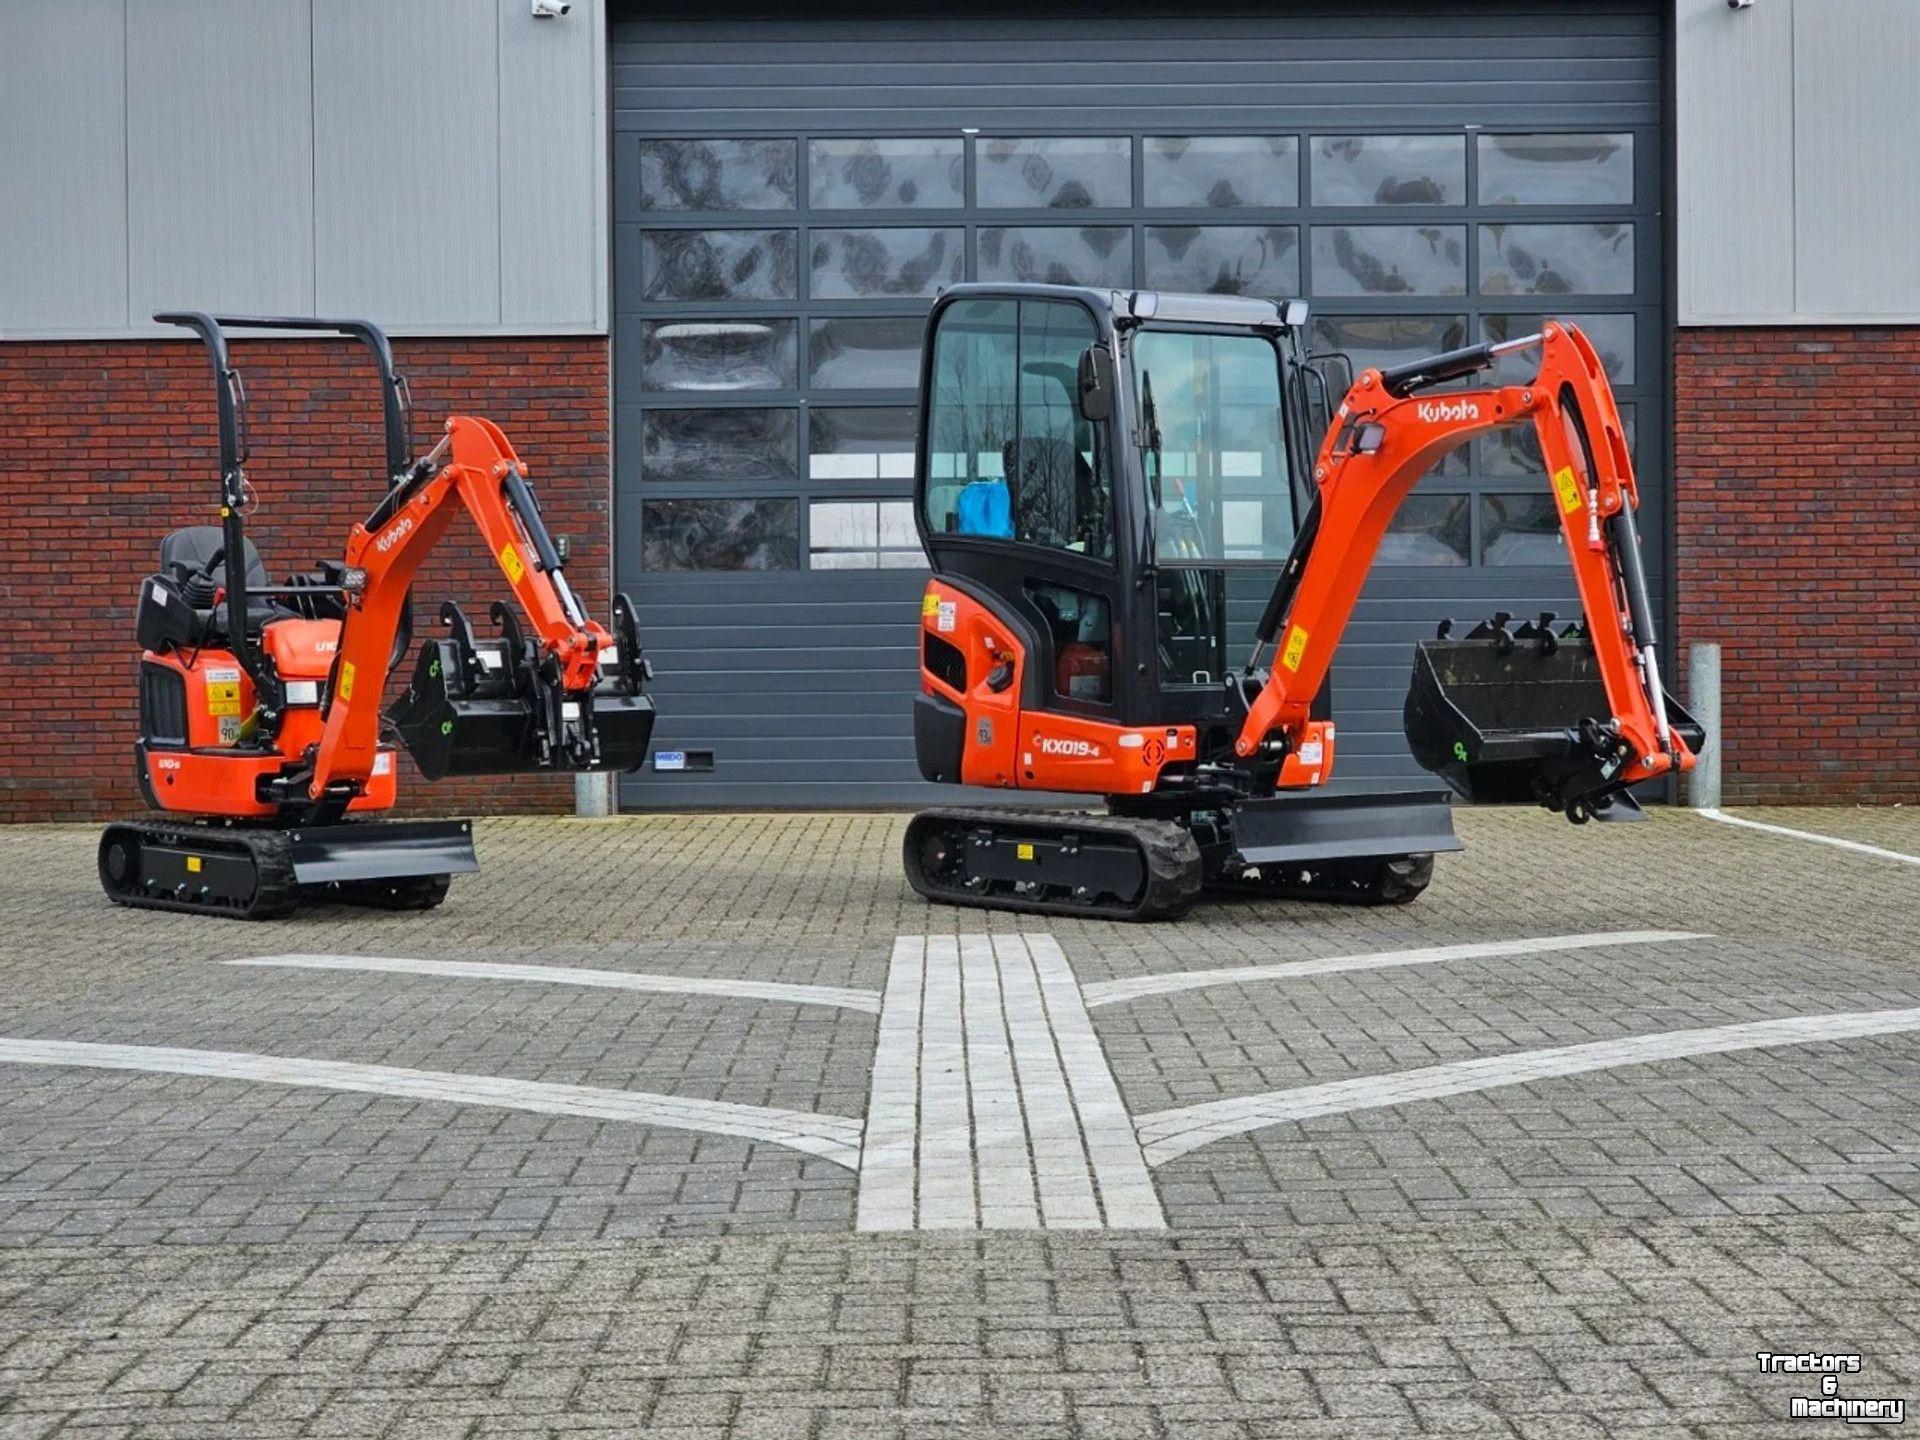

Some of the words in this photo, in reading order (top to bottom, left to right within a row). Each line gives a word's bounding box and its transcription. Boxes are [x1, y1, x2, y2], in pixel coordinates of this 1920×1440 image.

[1418, 399, 1479, 423] Kubota
[376, 517, 413, 552] Kubota
[1042, 738, 1100, 757] KX019-4
